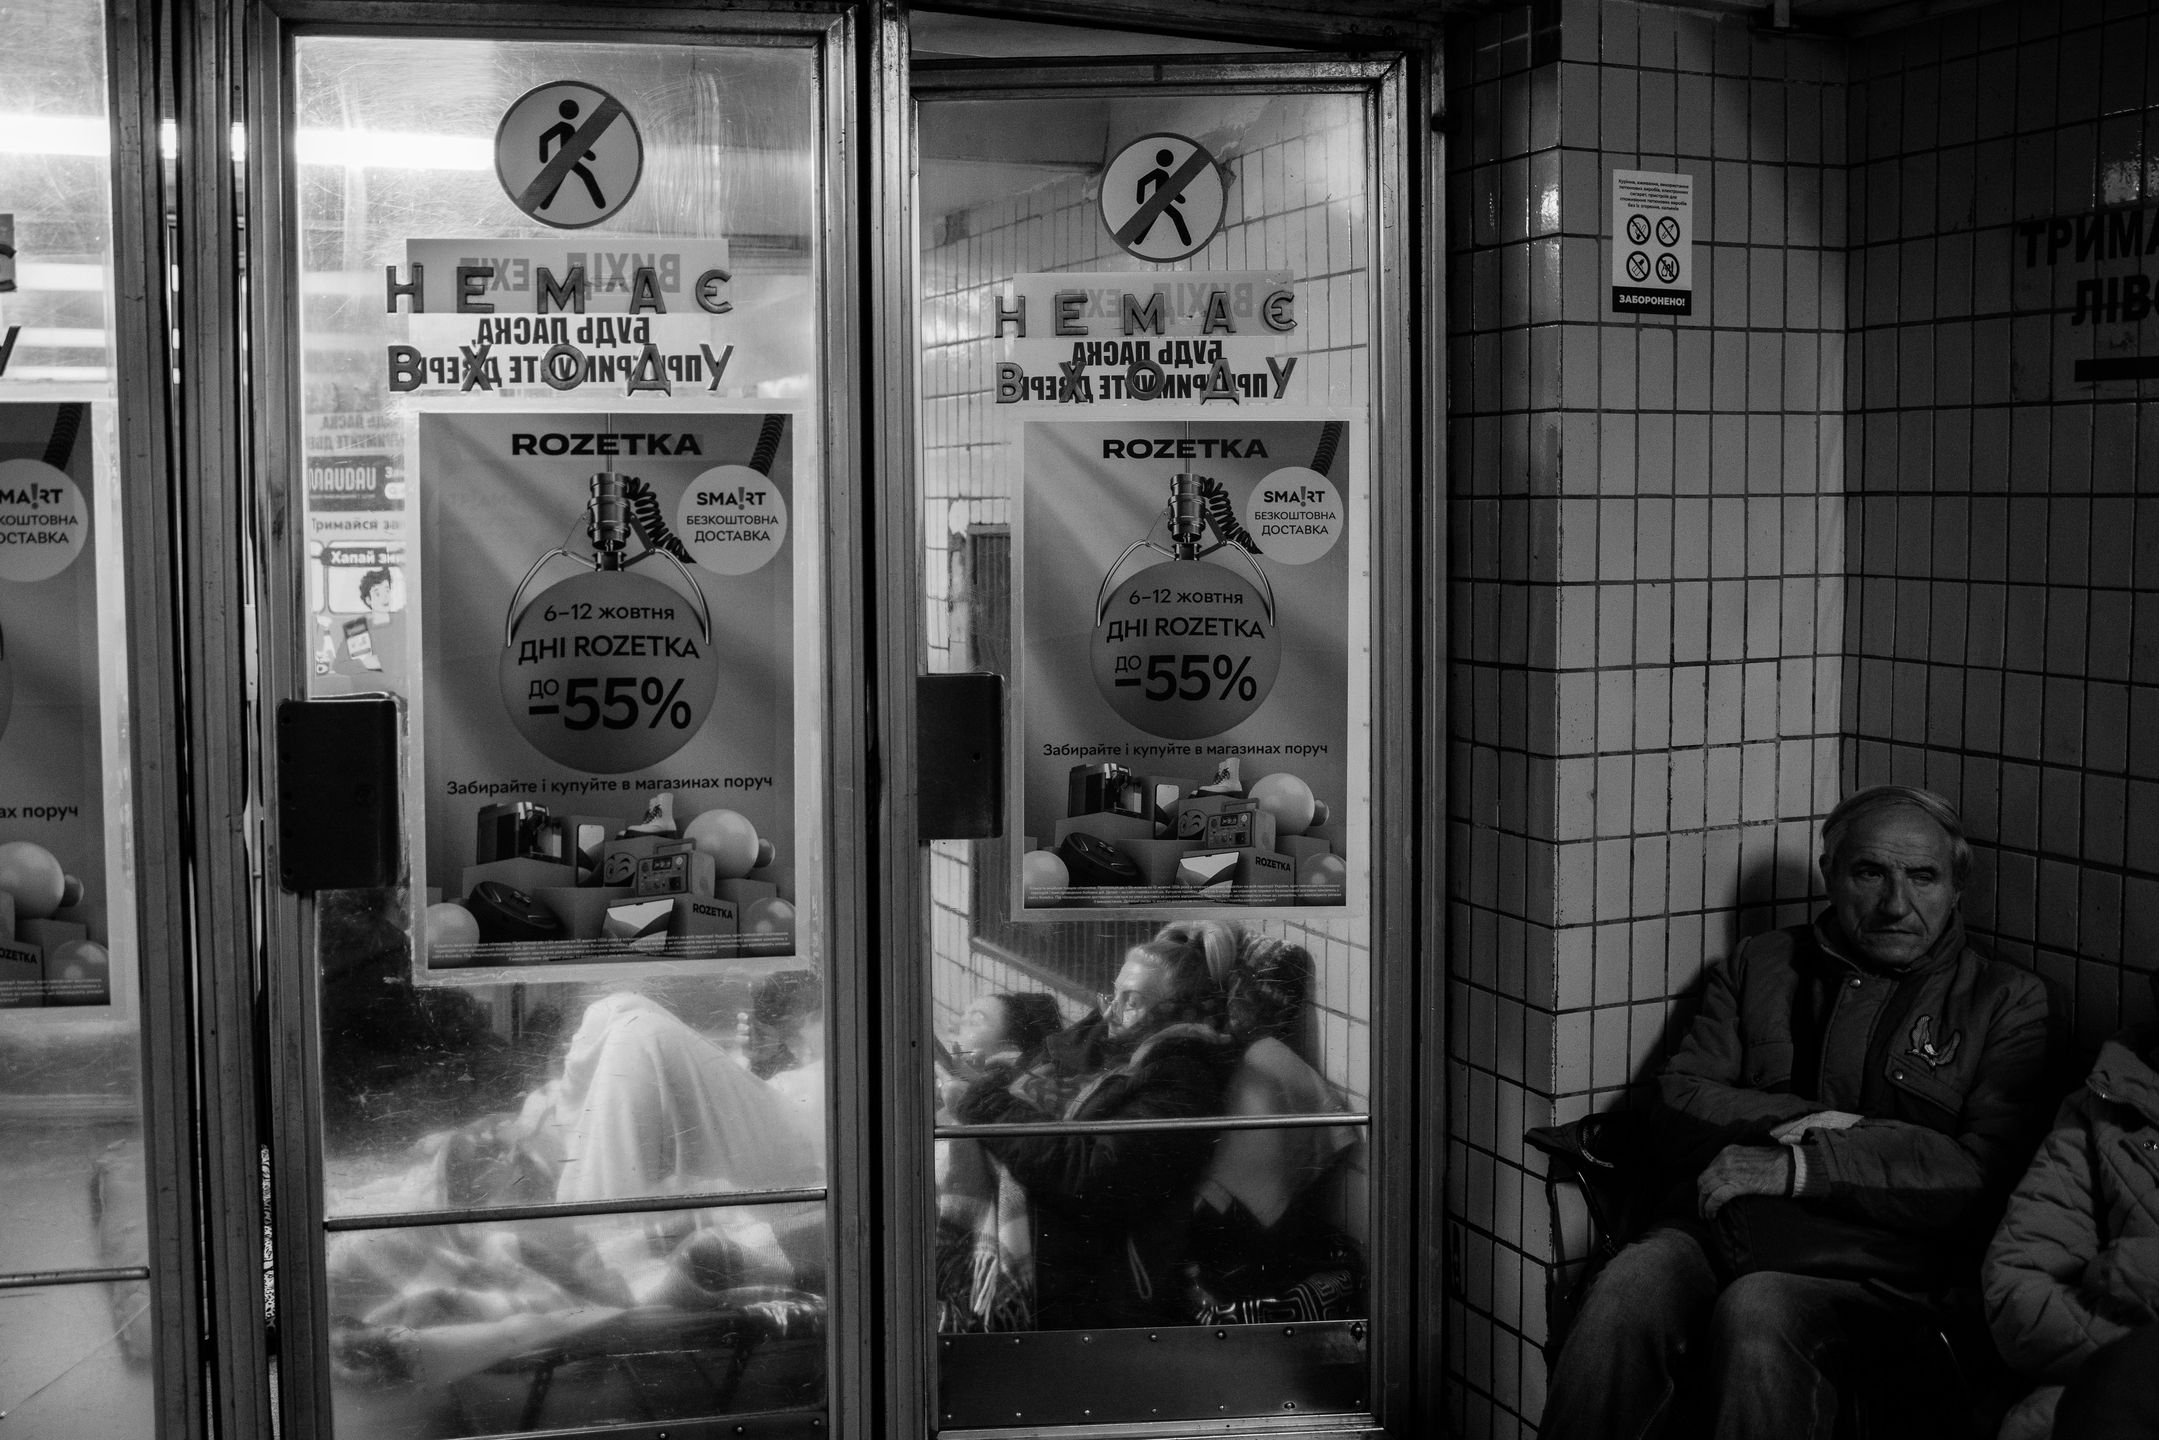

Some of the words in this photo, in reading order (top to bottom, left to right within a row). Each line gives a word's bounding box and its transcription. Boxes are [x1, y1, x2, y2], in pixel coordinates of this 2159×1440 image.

[1619, 295, 1686, 307] ЗАБОРОНЕНО!
[2071, 275, 2159, 326] ЛІВ
[512, 433, 702, 456] ROZETKA
[1102, 439, 1270, 459] ROZETKA
[686, 514, 779, 527] БЕЗКОШТОВНА
[1254, 511, 1336, 522] БЕЗКОШТОВНА
[694, 529, 771, 545] ДОСТАВКА
[1261, 524, 1329, 537] ДОСТАВКА
[331, 550, 375, 564] Хапай
[1176, 591, 1243, 604] жовтня
[598, 606, 675, 620] жовтня
[1106, 618, 1148, 643] ДНІ
[1155, 617, 1266, 639] ROZETKA
[518, 637, 566, 665] ДНІ
[574, 635, 700, 659] ROZETKA
[1114, 655, 1142, 673] ДО
[528, 679, 560, 700] ДО
[1043, 743, 1122, 759] Забирайте
[1126, 743, 1130, 755] і
[1133, 742, 1191, 759] купуйте
[1195, 745, 1203, 755] в
[1206, 744, 1281, 755] магазинах
[1284, 744, 1329, 758] поруч
[447, 778, 538, 797] Забирайте
[542, 778, 547, 793] і
[551, 778, 617, 796] купуйте
[622, 780, 631, 791] в
[635, 778, 719, 791] магазинах
[724, 776, 773, 793] поруч
[22, 804, 79, 821] поруч
[1255, 855, 1292, 873] ROZETKA
[692, 902, 735, 920] ROZETKA
